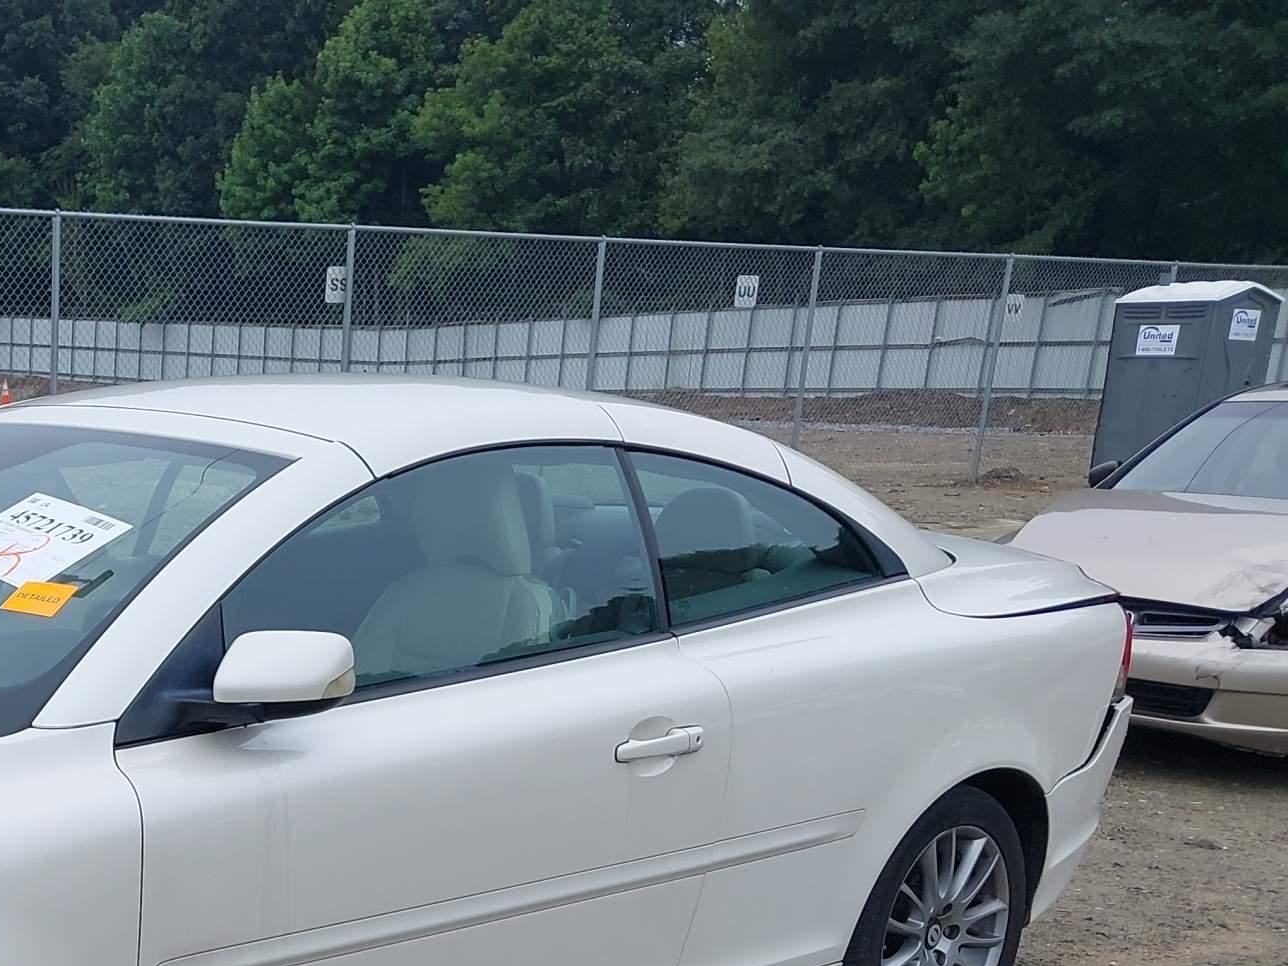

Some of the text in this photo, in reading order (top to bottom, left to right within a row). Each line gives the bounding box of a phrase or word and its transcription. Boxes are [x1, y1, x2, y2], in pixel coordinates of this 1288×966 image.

[738, 285, 756, 298] UU
[1143, 331, 1174, 340] United
[9, 509, 95, 545] 45721739
[16, 592, 61, 604] DETAILED
